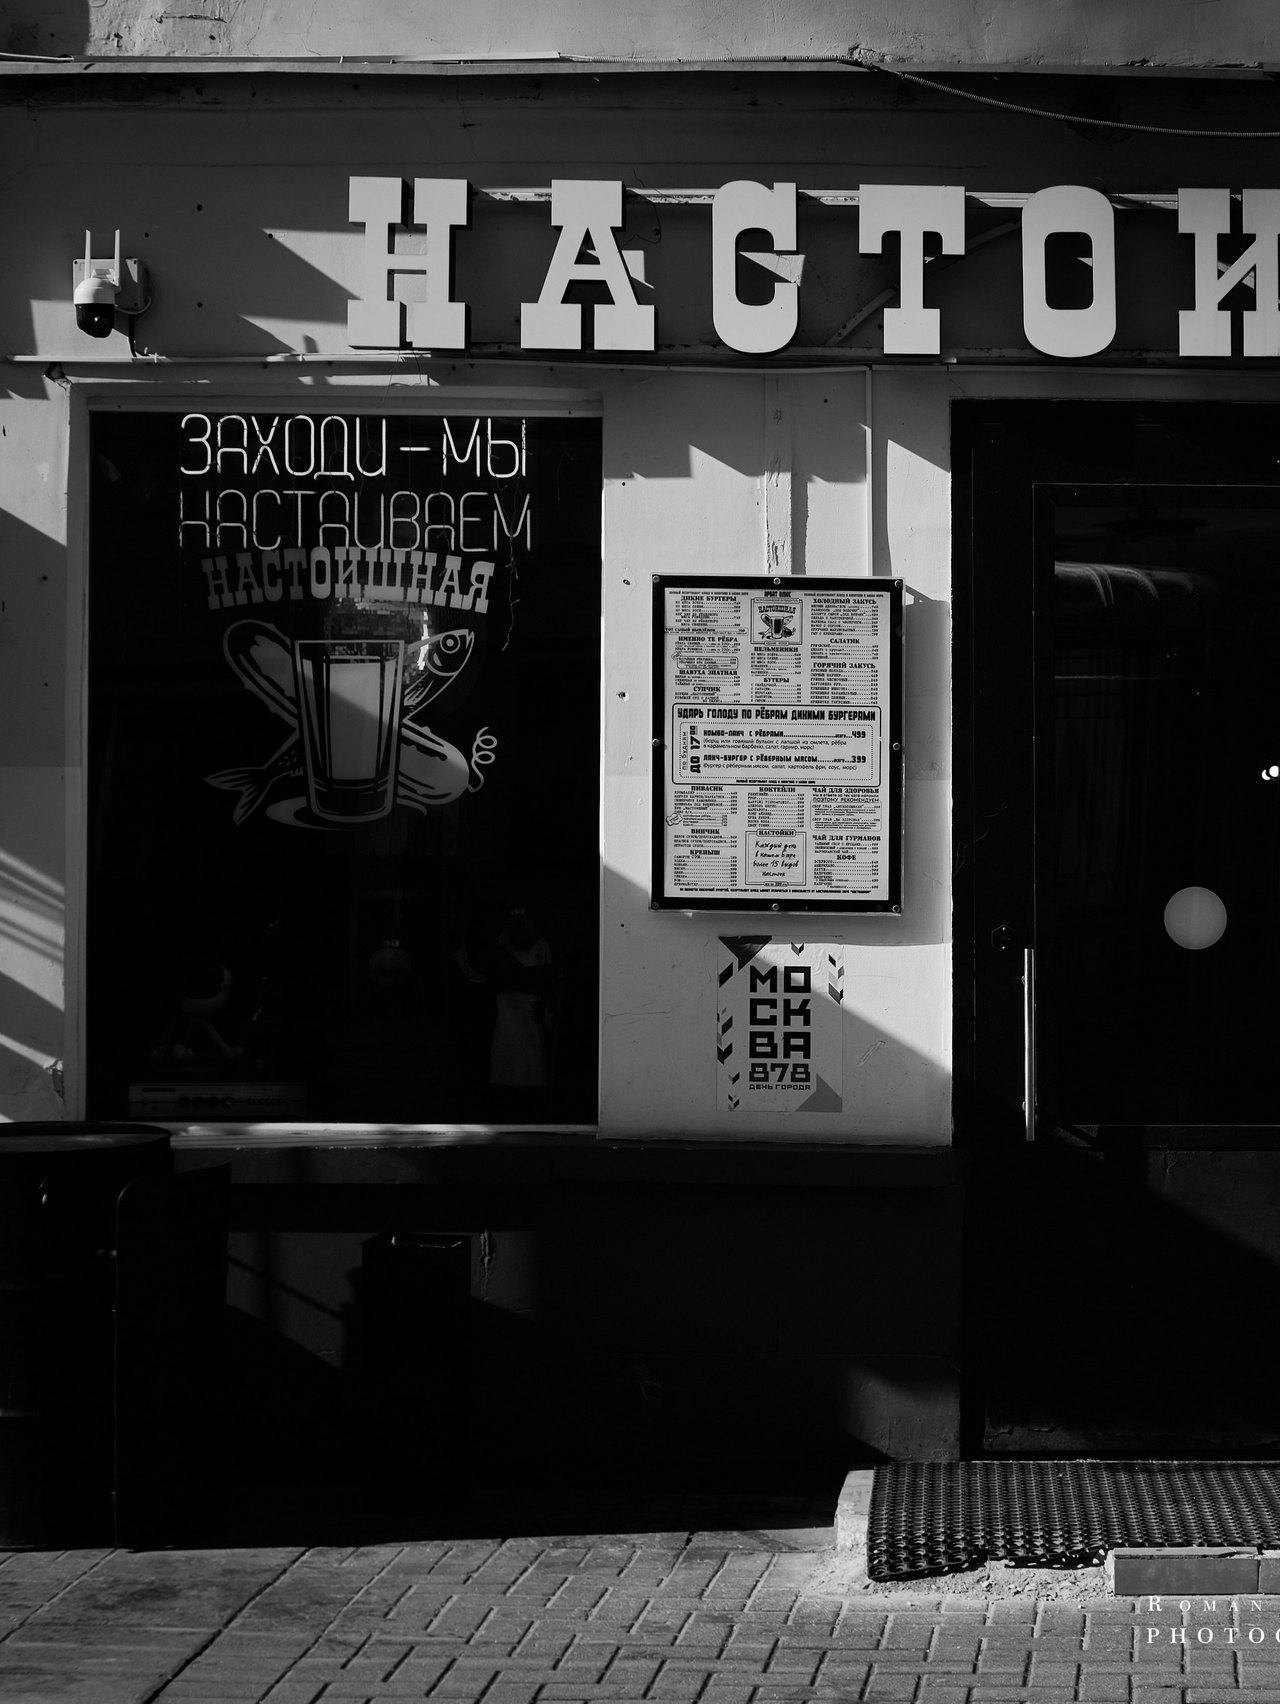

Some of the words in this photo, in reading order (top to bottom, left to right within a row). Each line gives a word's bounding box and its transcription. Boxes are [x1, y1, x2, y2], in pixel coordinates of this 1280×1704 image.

[179, 412, 387, 482] ЗАХОДИ
[442, 417, 529, 479] МЫ
[178, 488, 532, 553] НАСТАИВАЕМ
[200, 546, 496, 615] НАСТОИШНАЯ
[677, 708, 704, 719] УДАРЬ
[707, 708, 739, 720] ГОЛОДУ
[741, 709, 753, 719] ПО
[755, 706, 788, 720] РЁБРАМ
[791, 709, 825, 721] ДИКИМИ
[828, 710, 876, 721] БУРГЕРАМИ
[755, 728, 784, 737] РЁБРАМИ
[851, 730, 867, 739] 499
[703, 754, 748, 762] ЛАНЧ-БУРГЕР
[756, 753, 792, 762] РЁБЕРНЫМ
[794, 755, 818, 763] МЯСОМ
[851, 755, 867, 763] 399
[690, 755, 701, 774] ДО
[759, 785, 796, 793] КОКТЕЙЛИ
[812, 786, 827, 794] ЧАЙ
[755, 841, 783, 851] Каждый
[770, 859, 780, 868] 15
[748, 1062, 811, 1083] 878
[748, 1083, 773, 1091] ДЕНЬ
